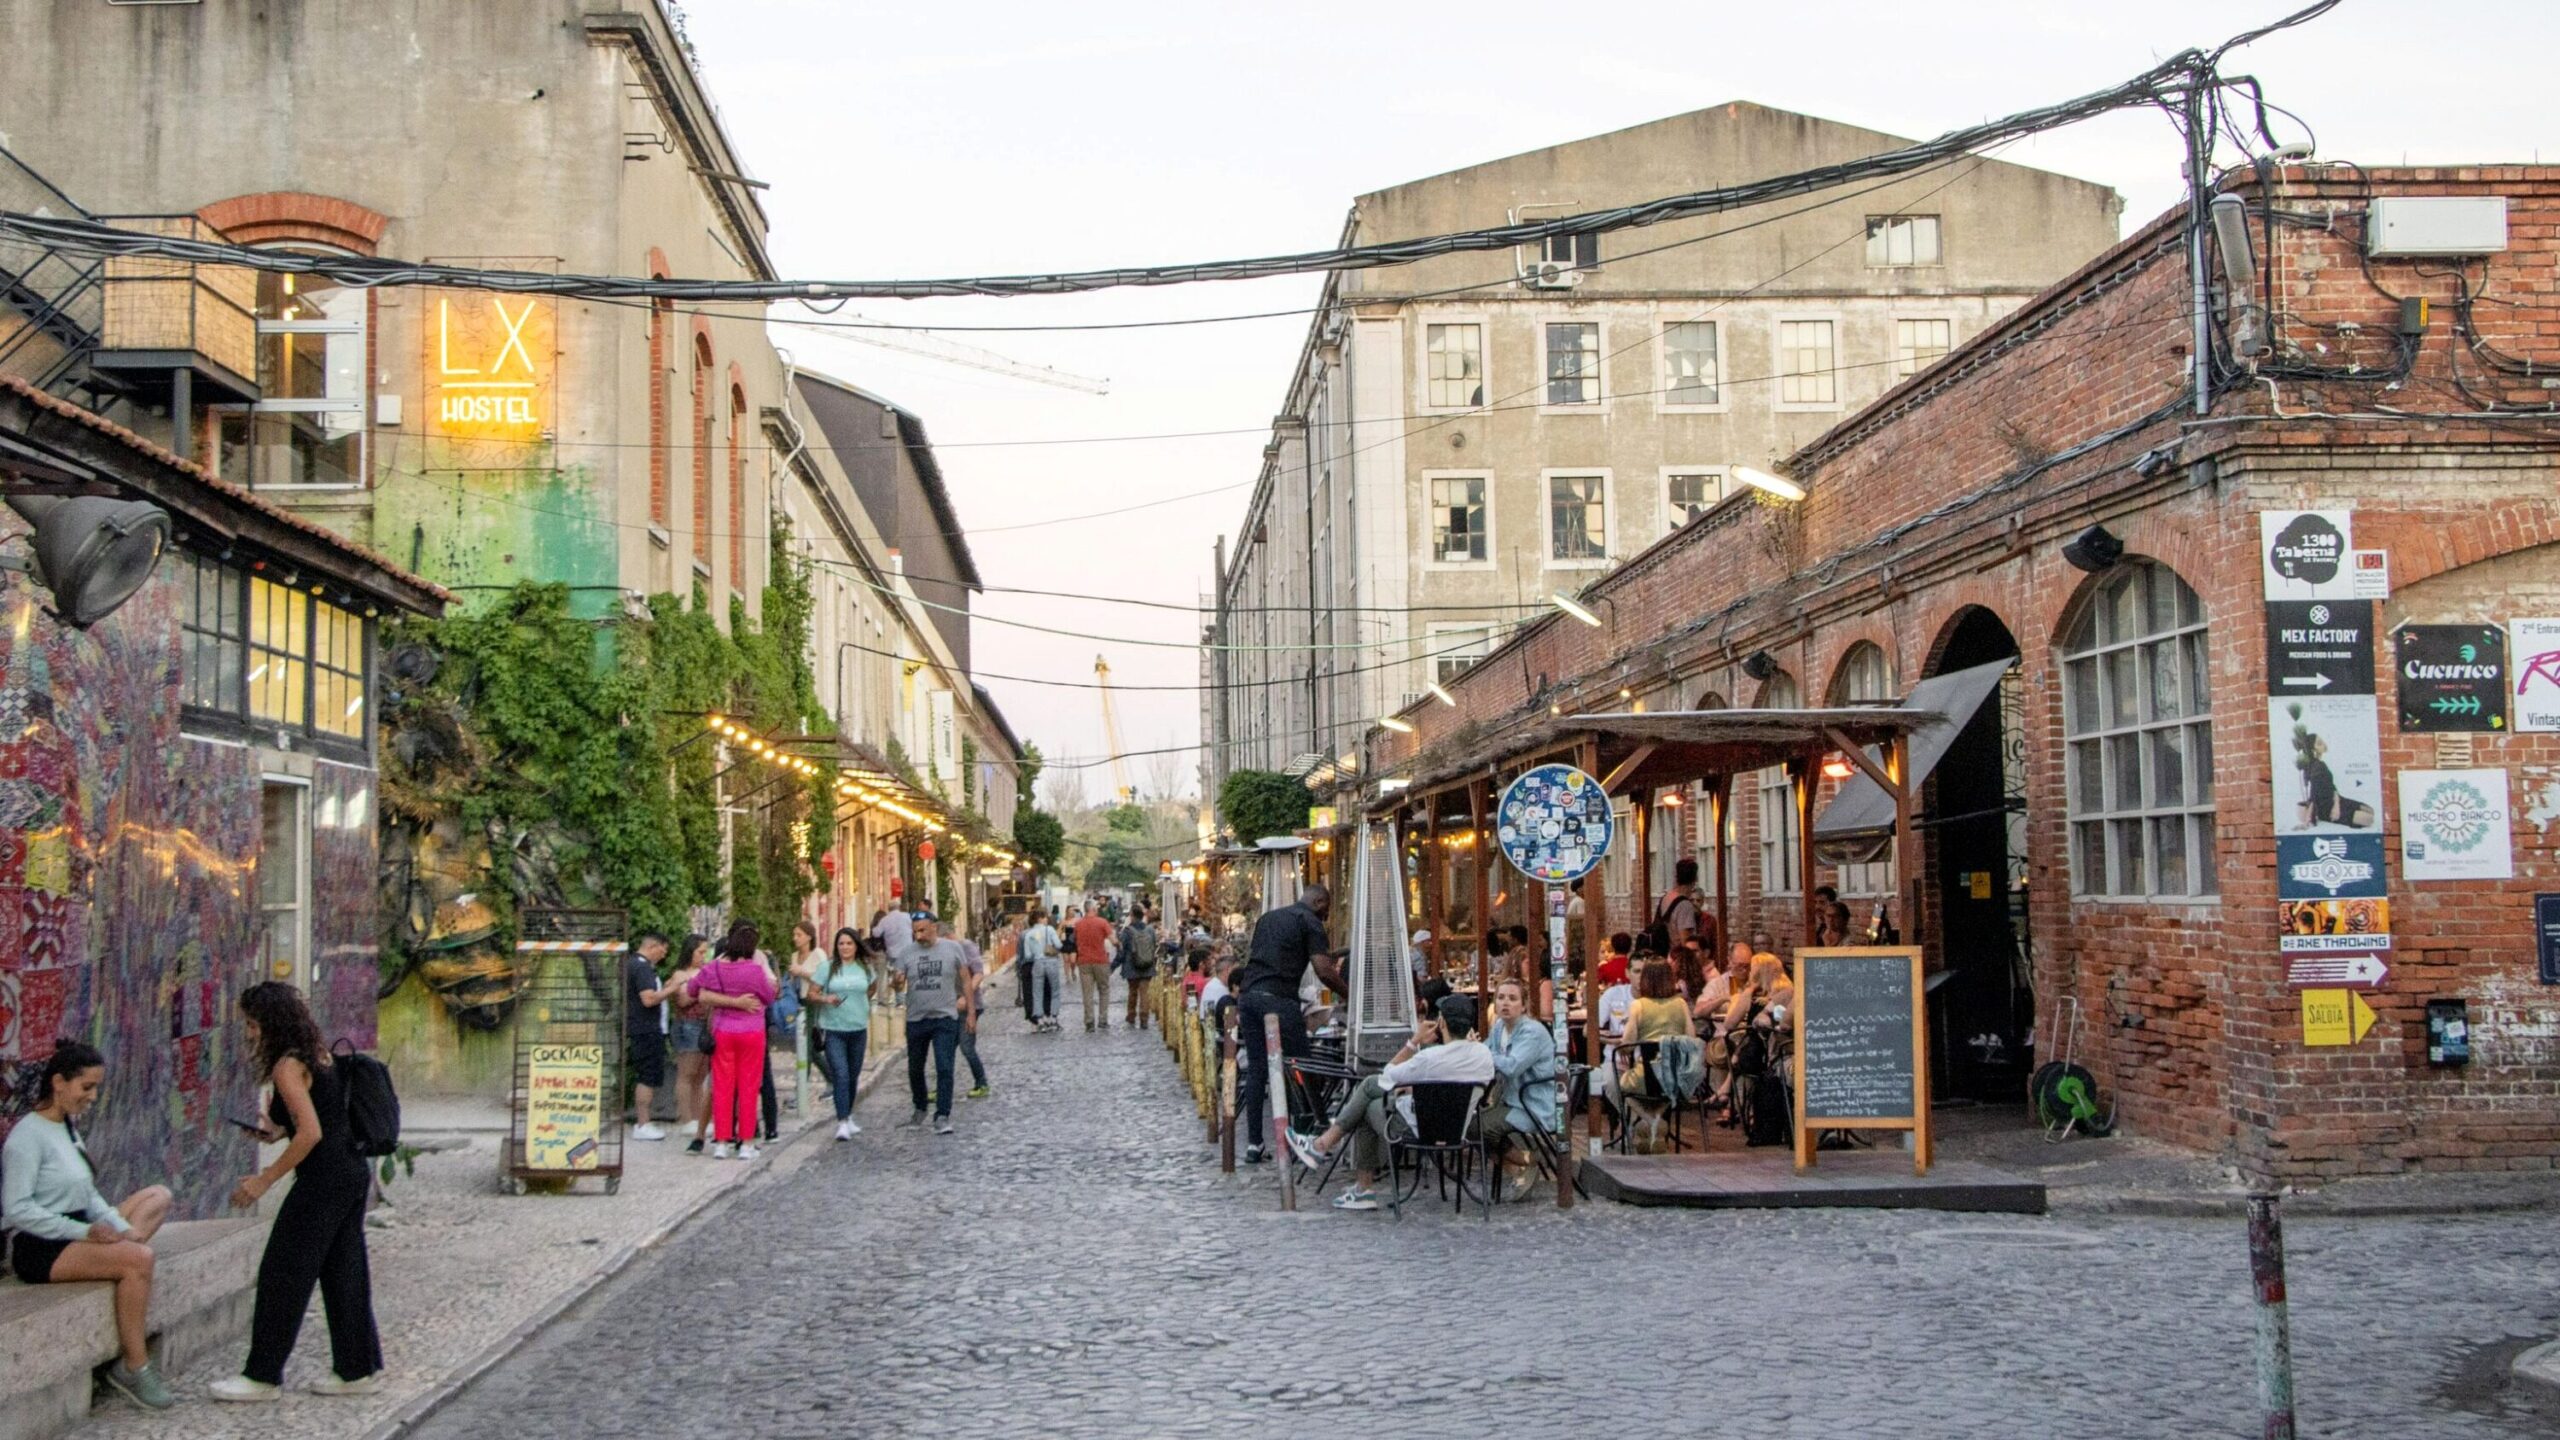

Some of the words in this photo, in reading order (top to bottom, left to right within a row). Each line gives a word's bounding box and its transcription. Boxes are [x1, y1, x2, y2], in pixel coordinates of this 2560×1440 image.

[440, 298, 537, 375] LX
[441, 395, 537, 424] HOSTEL
[2301, 533, 2337, 547] 1300
[2275, 546, 2337, 558] Taberna
[2281, 629, 2306, 643] MEX
[2308, 629, 2358, 643] FACTORY
[2407, 811, 2456, 822] MUSCHIO
[2460, 810, 2501, 821] BIANCO
[2323, 936, 2387, 947] THROWING
[533, 1046, 600, 1065] COCKTAILS
